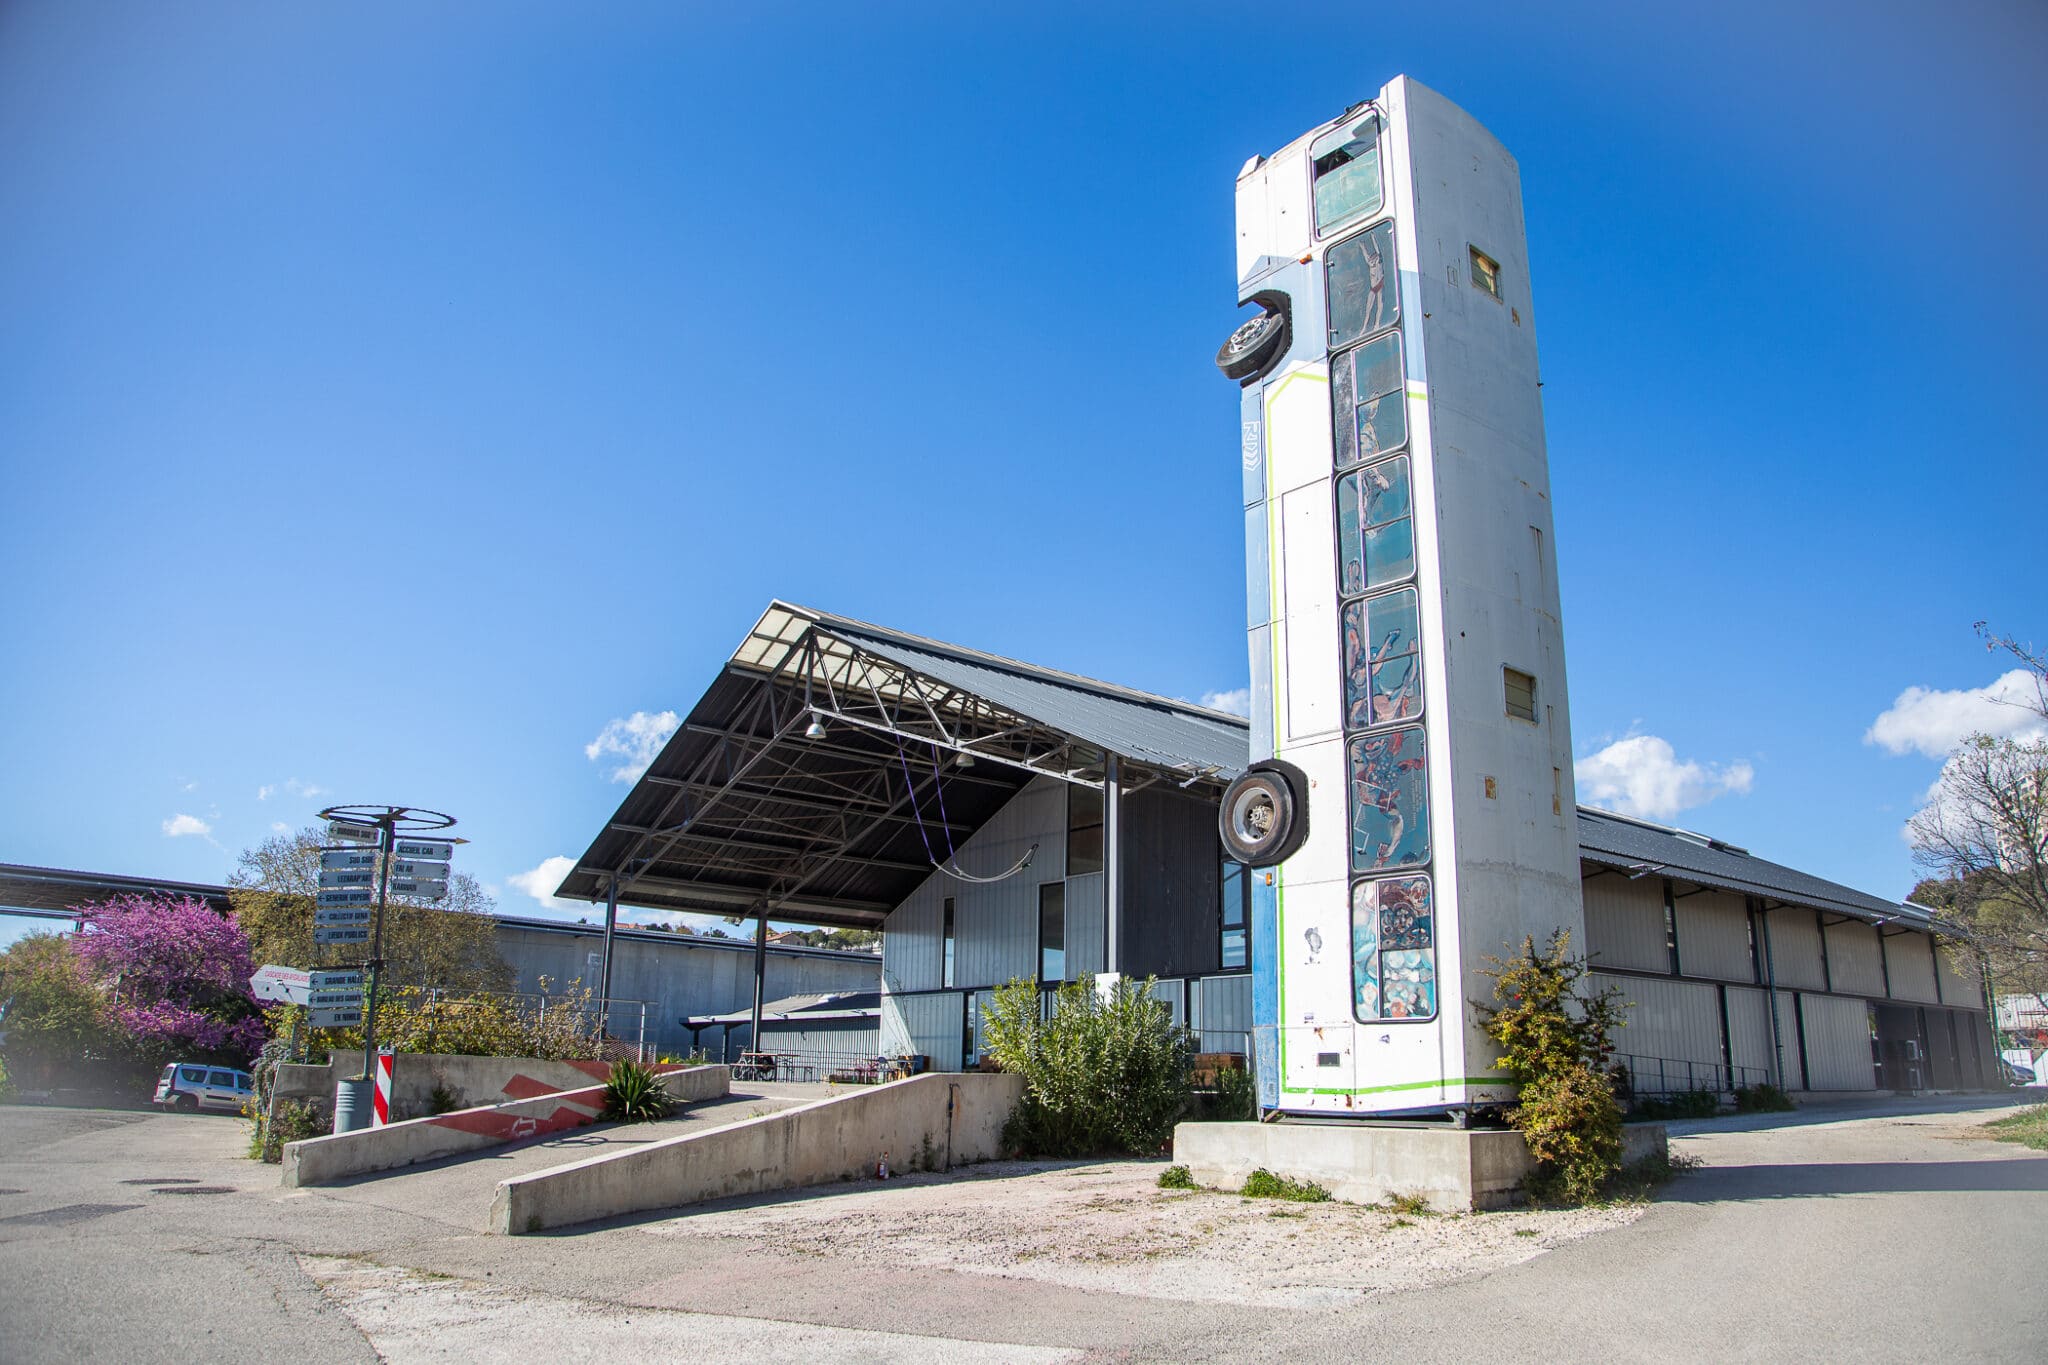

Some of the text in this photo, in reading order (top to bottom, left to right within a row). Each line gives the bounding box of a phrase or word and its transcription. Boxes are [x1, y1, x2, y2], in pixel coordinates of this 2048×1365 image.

[328, 930, 367, 940] LIEUX PUBLICS
[348, 975, 364, 983] HALLE
